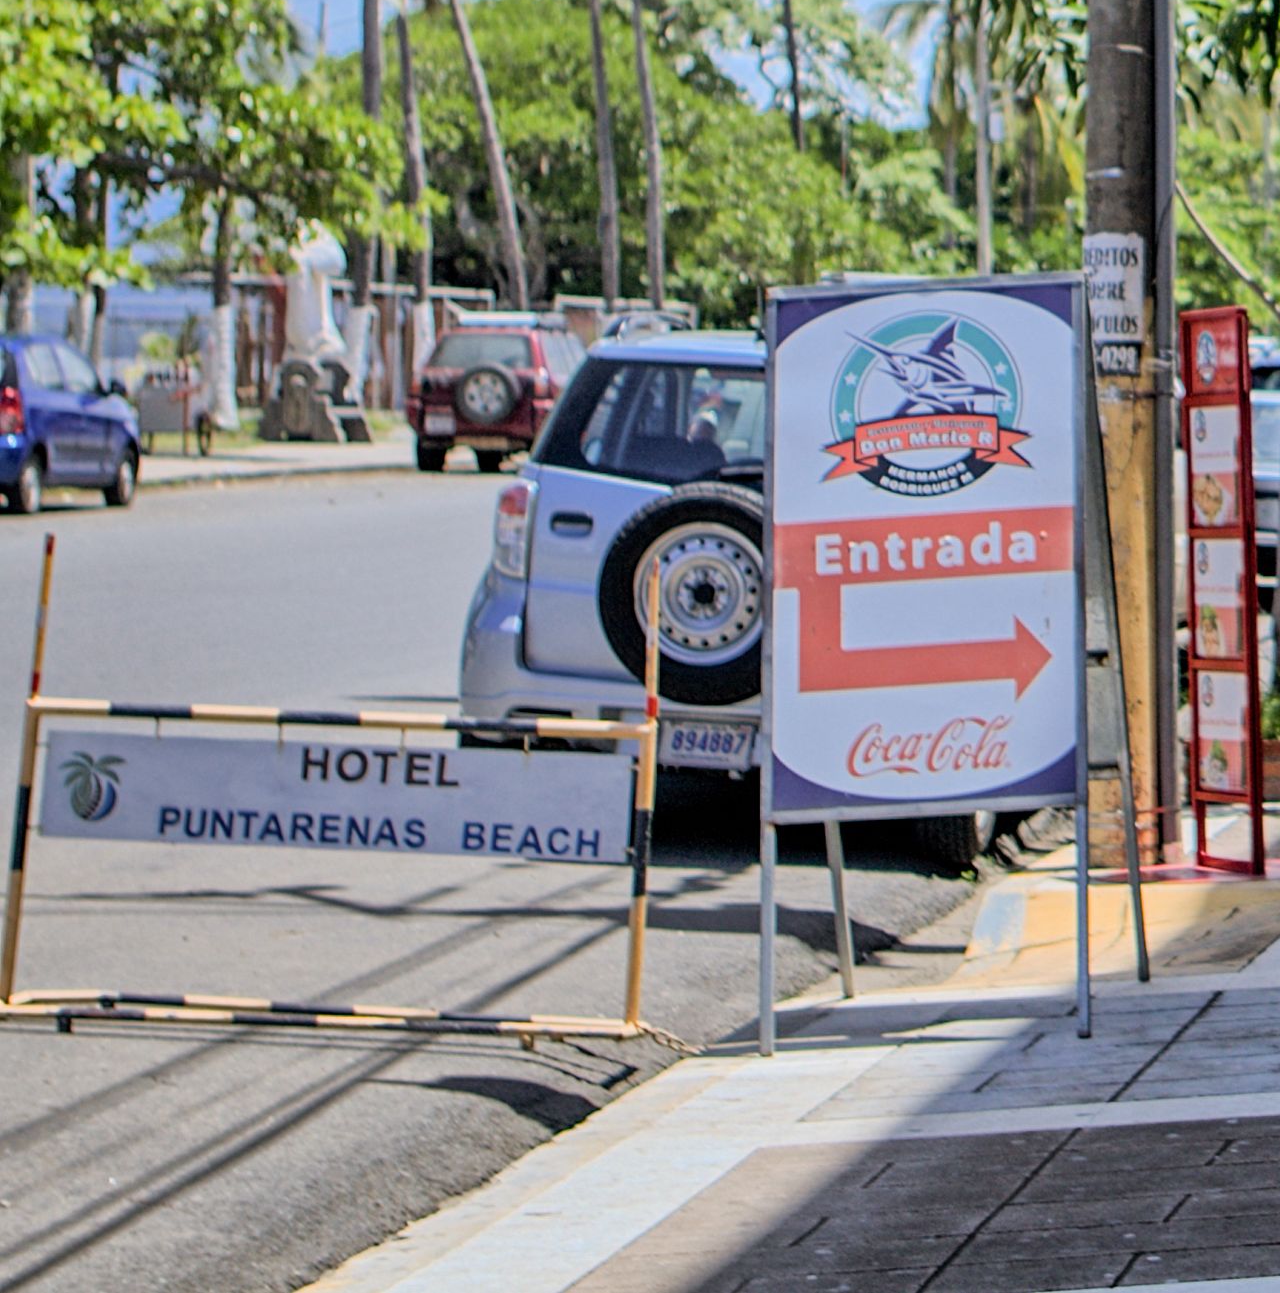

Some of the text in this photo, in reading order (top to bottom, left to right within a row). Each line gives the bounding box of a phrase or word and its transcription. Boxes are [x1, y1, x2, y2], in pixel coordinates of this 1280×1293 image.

[859, 430, 993, 456] Don Mario R
[887, 461, 967, 483] HERMANOS
[814, 520, 1037, 576] Entrada
[301, 746, 460, 788] HOTEL
[845, 714, 1014, 779] Coca-Cola
[158, 806, 602, 858] PUNTARENAS BEACH
